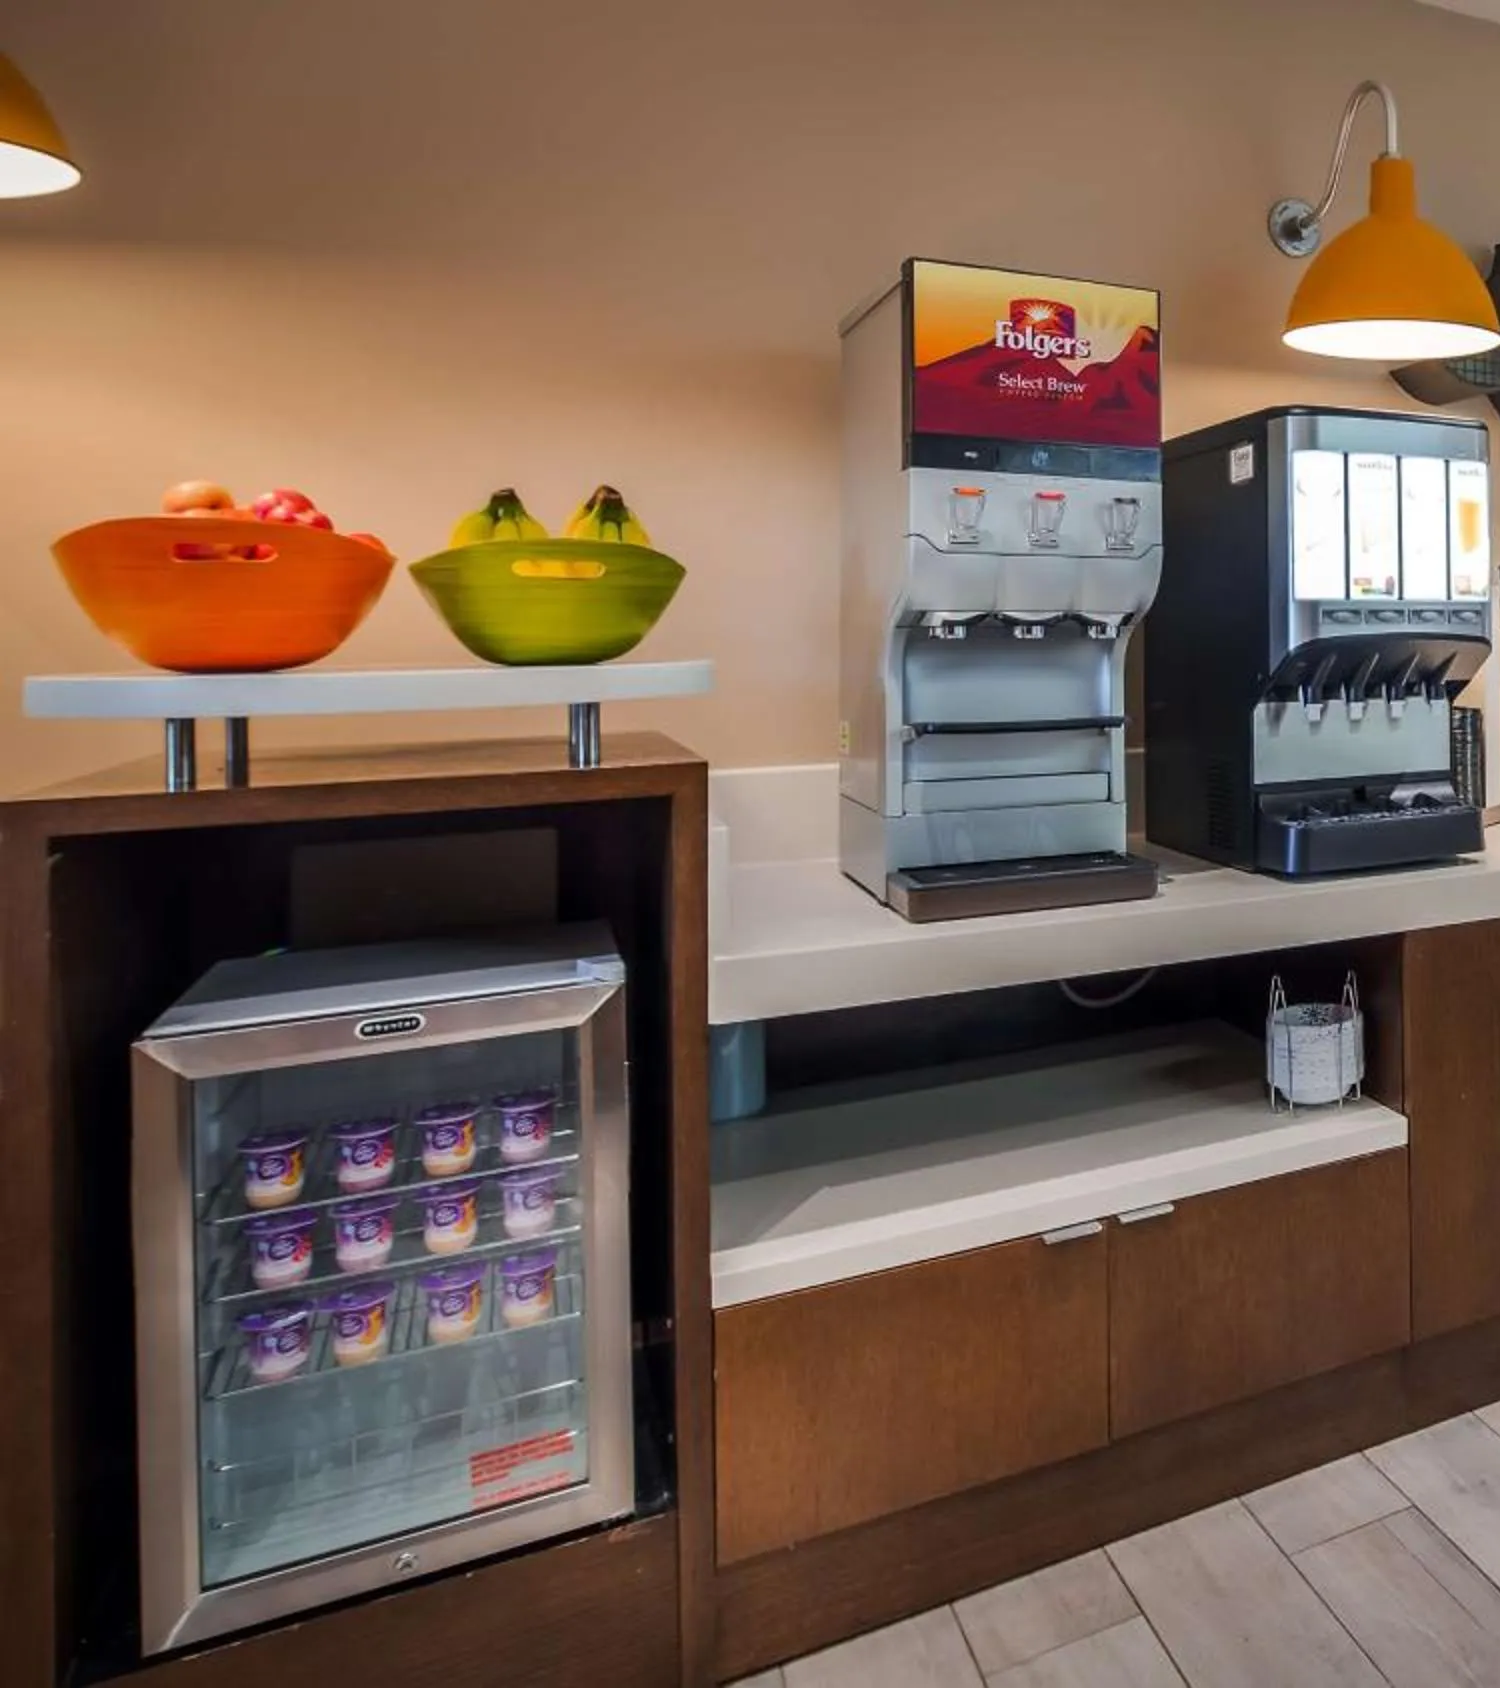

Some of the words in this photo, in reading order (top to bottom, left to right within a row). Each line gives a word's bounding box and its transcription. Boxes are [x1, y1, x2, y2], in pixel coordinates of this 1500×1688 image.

[995, 319, 1091, 359] Folgers
[998, 372, 1043, 389] Select
[1047, 377, 1087, 393] Brew
